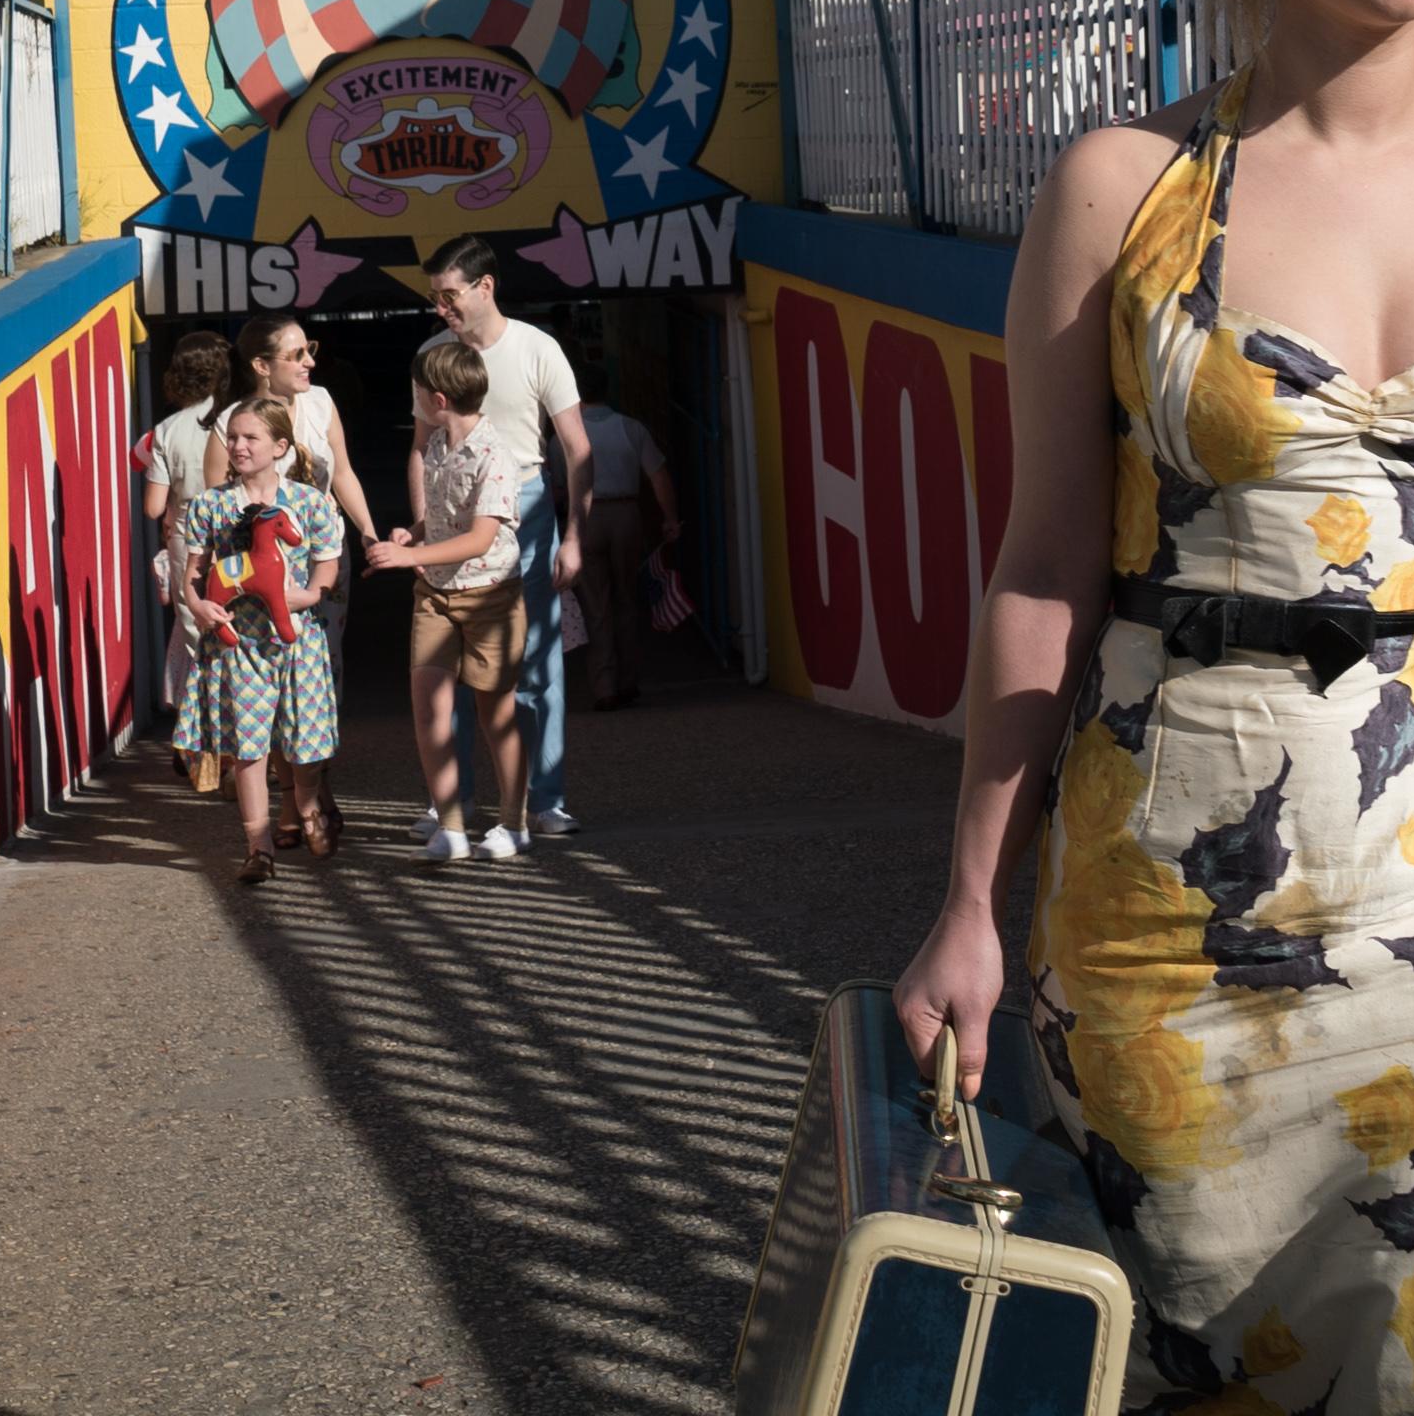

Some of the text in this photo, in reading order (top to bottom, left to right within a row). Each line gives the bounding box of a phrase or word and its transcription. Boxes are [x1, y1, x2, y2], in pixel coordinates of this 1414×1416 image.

[341, 65, 518, 104] EXCITEMENT
[367, 134, 490, 175] THRILLS
[134, 195, 745, 316] THIS WAY
